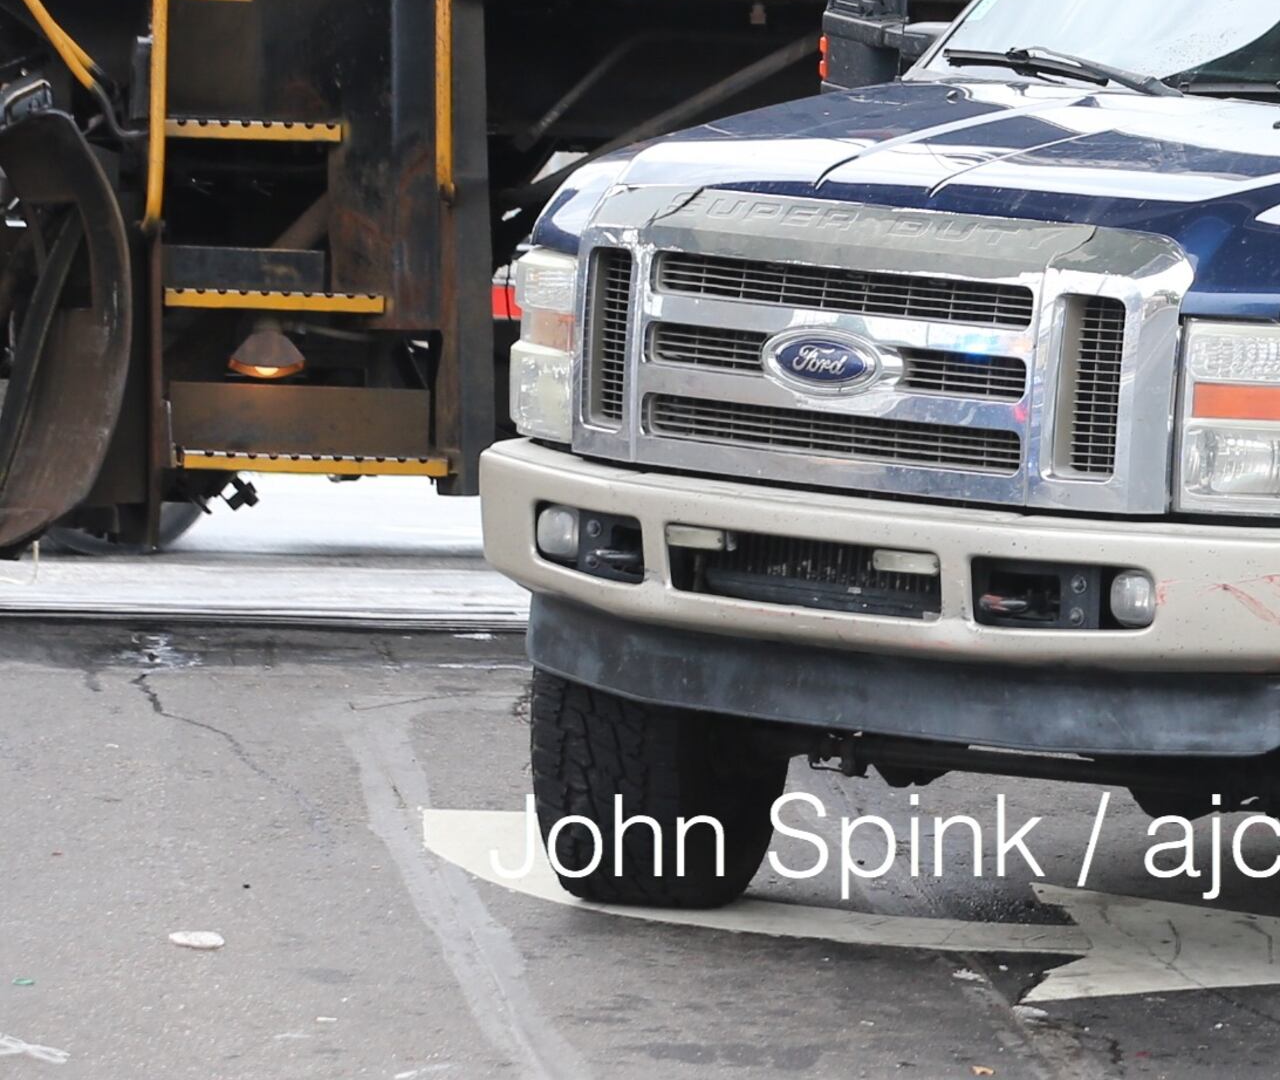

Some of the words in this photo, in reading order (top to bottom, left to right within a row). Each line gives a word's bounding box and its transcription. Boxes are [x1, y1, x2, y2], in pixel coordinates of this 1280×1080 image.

[670, 190, 861, 233] SUPER
[886, 216, 1096, 251] DUTY
[791, 344, 849, 376] Ford
